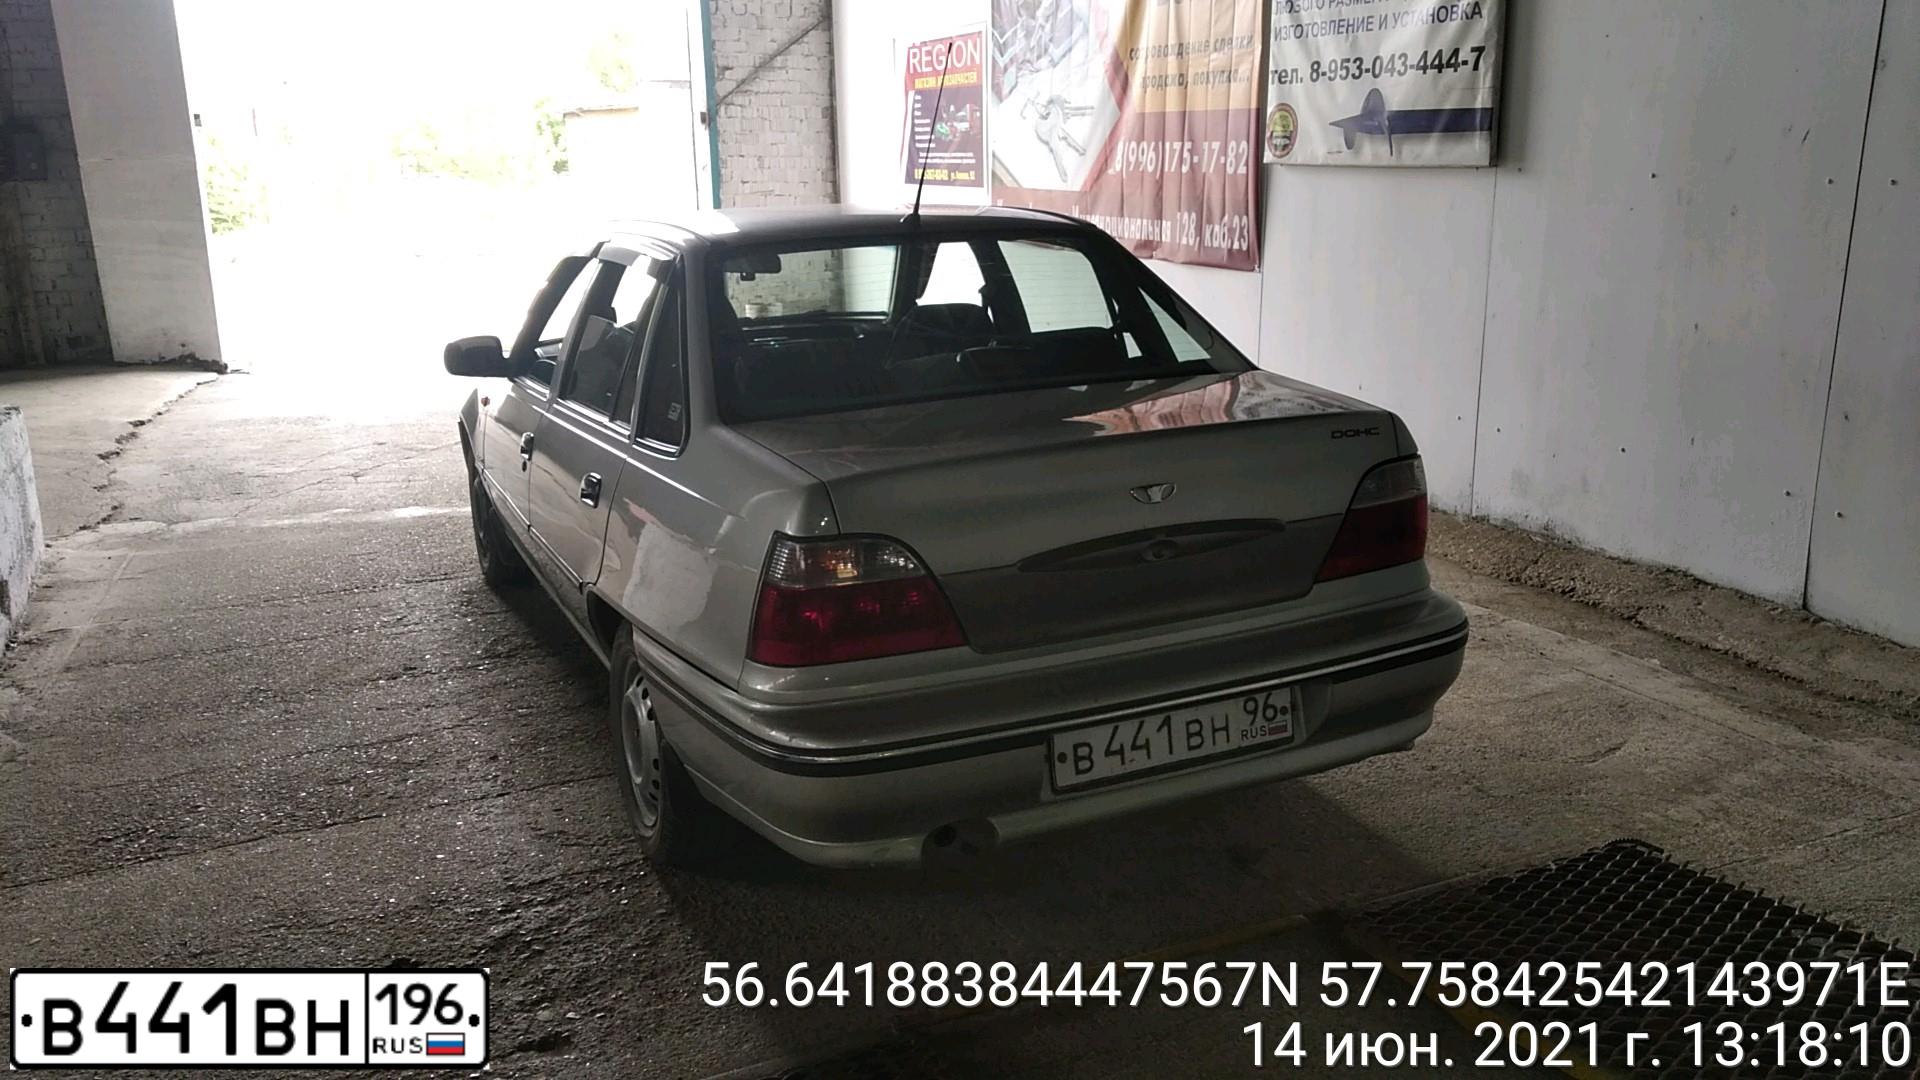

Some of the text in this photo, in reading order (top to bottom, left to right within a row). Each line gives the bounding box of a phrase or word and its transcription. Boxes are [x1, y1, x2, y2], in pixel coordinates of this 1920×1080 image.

[1274, 1, 1483, 42] ИЗГОТОВЛЕНИЕ И УСТАНОВКА
[909, 38, 981, 74] REGION
[1270, 46, 1486, 85] тел. 8-953-043-444-7
[1114, 139, 1249, 179] 8(996)175-17-82
[1331, 426, 1380, 439] DOHC
[1243, 692, 1278, 726] 96
[1072, 713, 1230, 776] В441ВН
[1240, 725, 1267, 741] RUS
